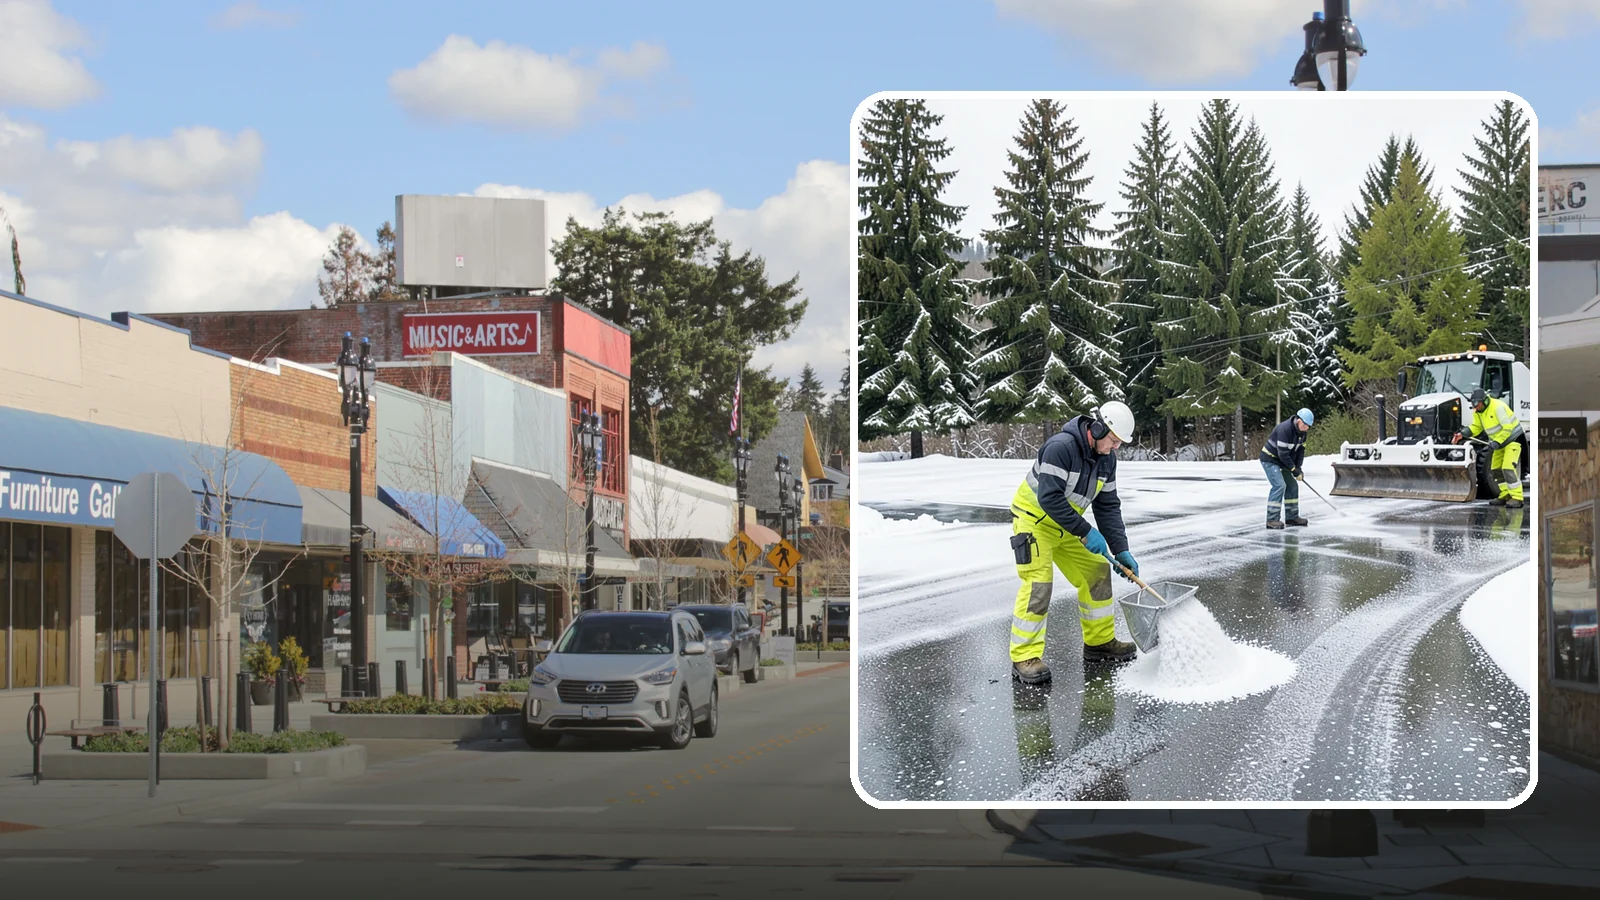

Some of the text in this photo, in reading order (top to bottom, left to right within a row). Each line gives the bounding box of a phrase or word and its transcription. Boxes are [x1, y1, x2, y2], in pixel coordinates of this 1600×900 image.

[0, 471, 122, 519] Furniture Gal
[453, 563, 479, 574] SUSHI
